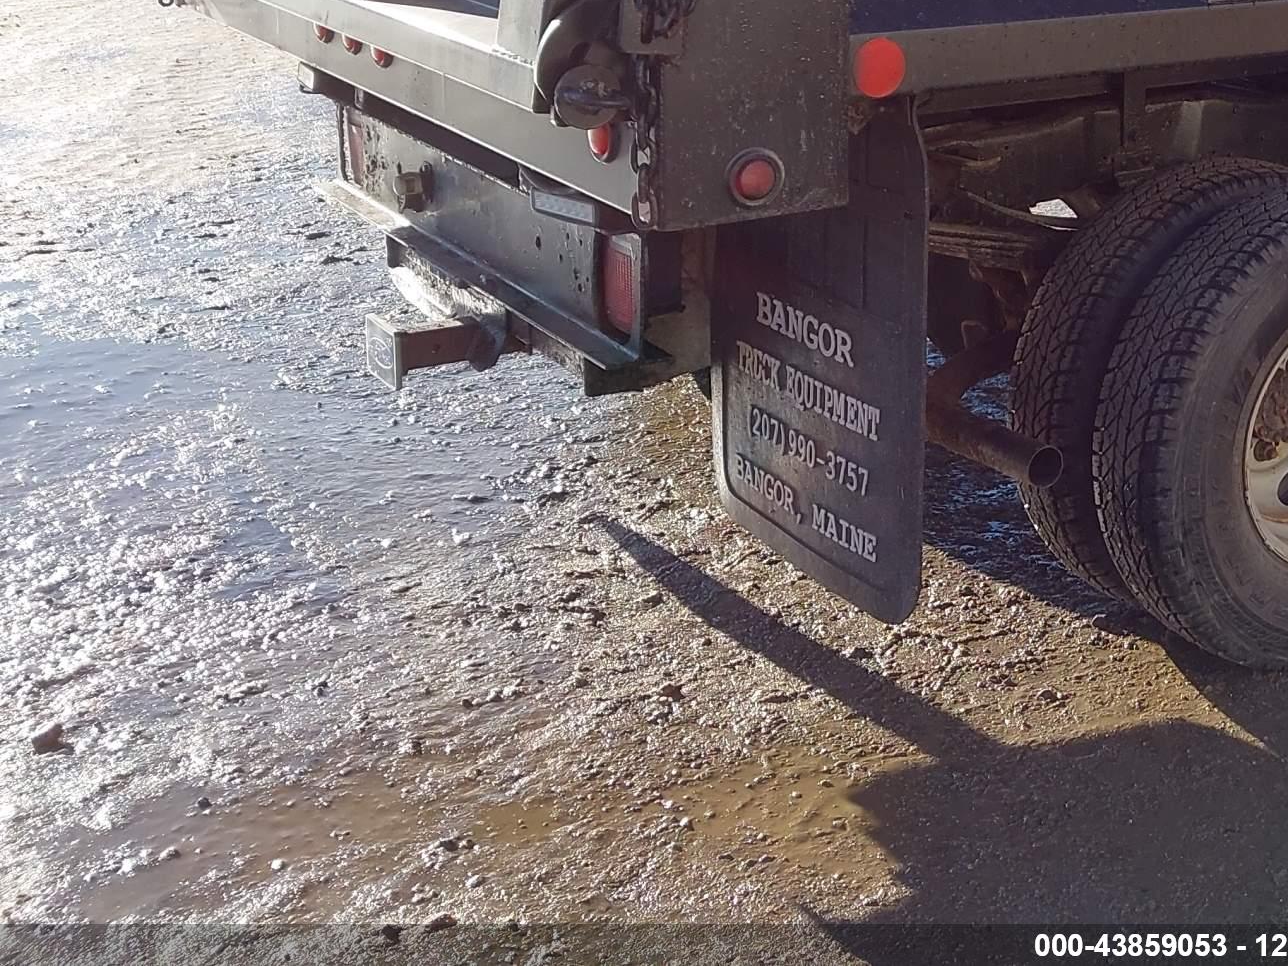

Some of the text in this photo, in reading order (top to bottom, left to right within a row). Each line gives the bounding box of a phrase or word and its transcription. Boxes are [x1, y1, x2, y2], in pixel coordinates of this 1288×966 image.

[756, 291, 854, 367] BANGOR
[736, 339, 880, 441] TRUCK EQUIPMENT
[735, 452, 878, 563] BANGOR, MAINE
